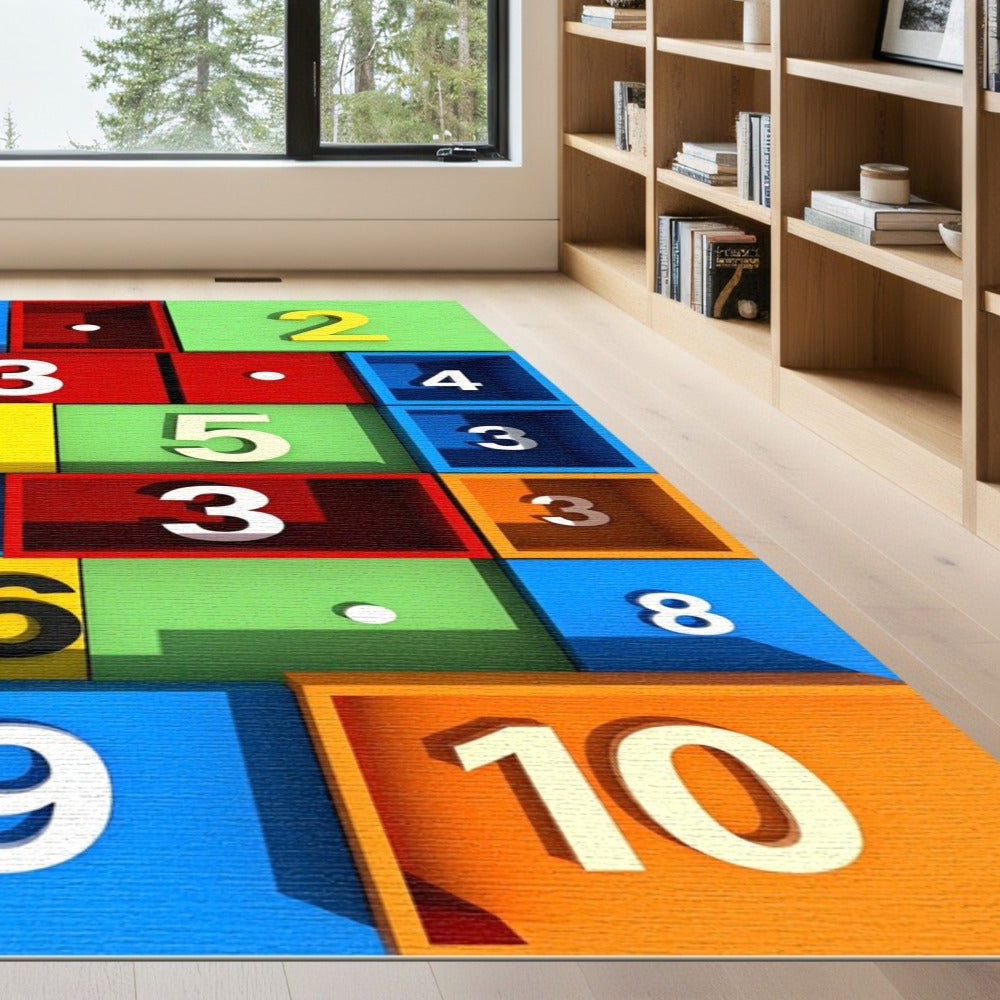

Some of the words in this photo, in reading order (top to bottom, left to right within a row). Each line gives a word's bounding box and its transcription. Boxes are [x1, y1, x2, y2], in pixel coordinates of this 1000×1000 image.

[279, 311, 388, 342] 2
[423, 370, 482, 391] 4
[174, 414, 290, 462] 5
[469, 425, 538, 450] 3
[161, 485, 285, 541] 3
[530, 496, 610, 527] 3
[637, 593, 734, 635] 8
[454, 724, 864, 873] 10
